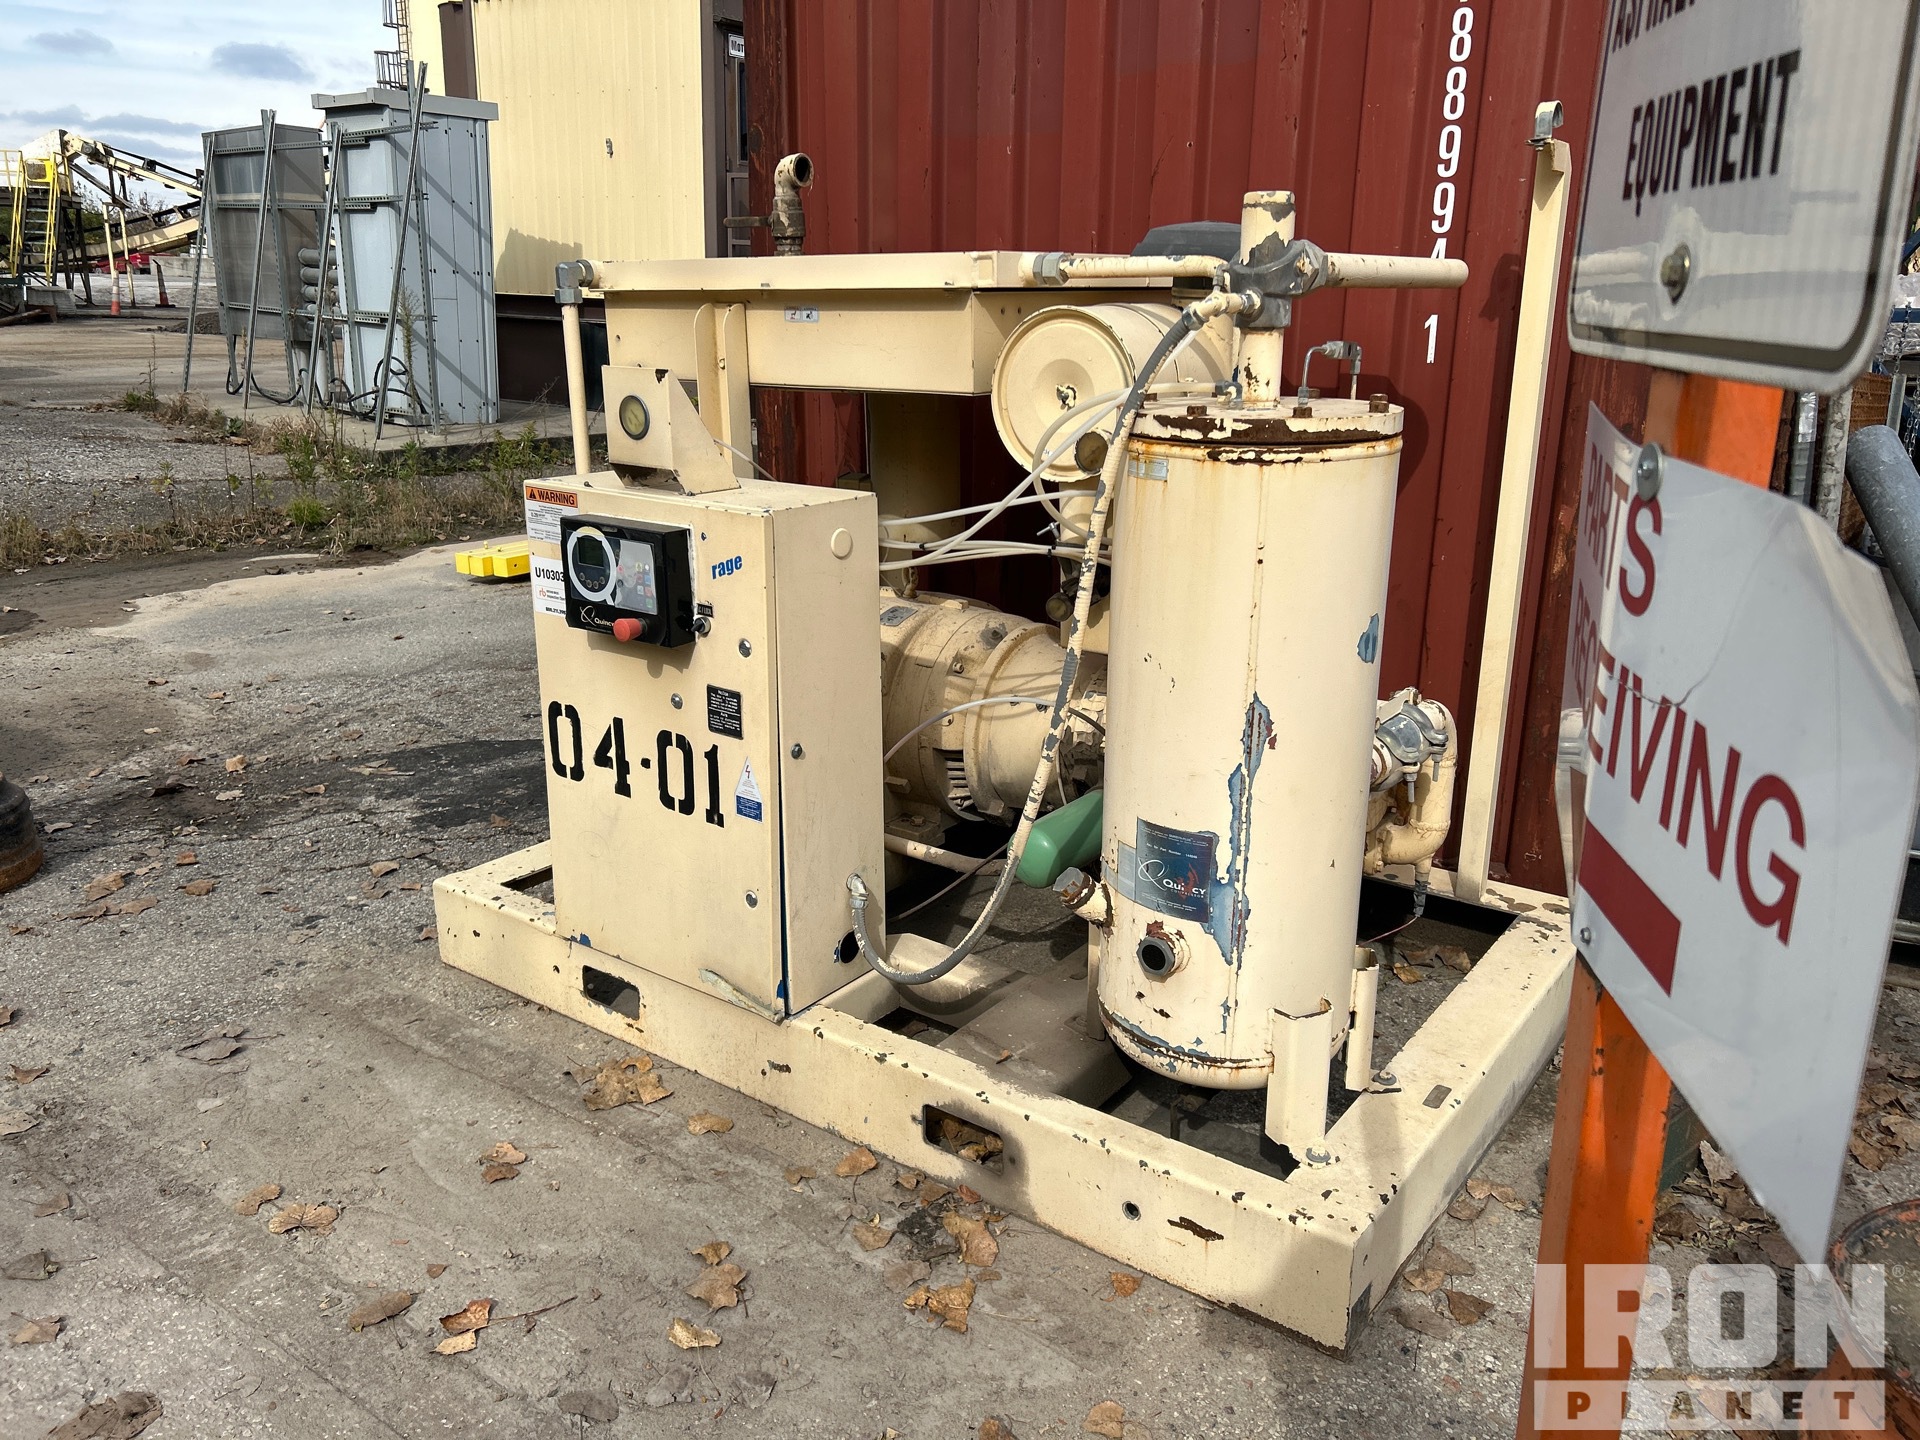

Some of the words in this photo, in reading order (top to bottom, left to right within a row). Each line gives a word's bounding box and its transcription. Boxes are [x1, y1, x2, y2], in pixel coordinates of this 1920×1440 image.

[1621, 48, 1802, 216] EQUIPMENT
[537, 490, 575, 506] WARNING
[711, 555, 743, 580] rage
[1583, 441, 1663, 619] PARTS
[547, 700, 725, 829] 04-01
[1572, 580, 1807, 947] RECEIVING
